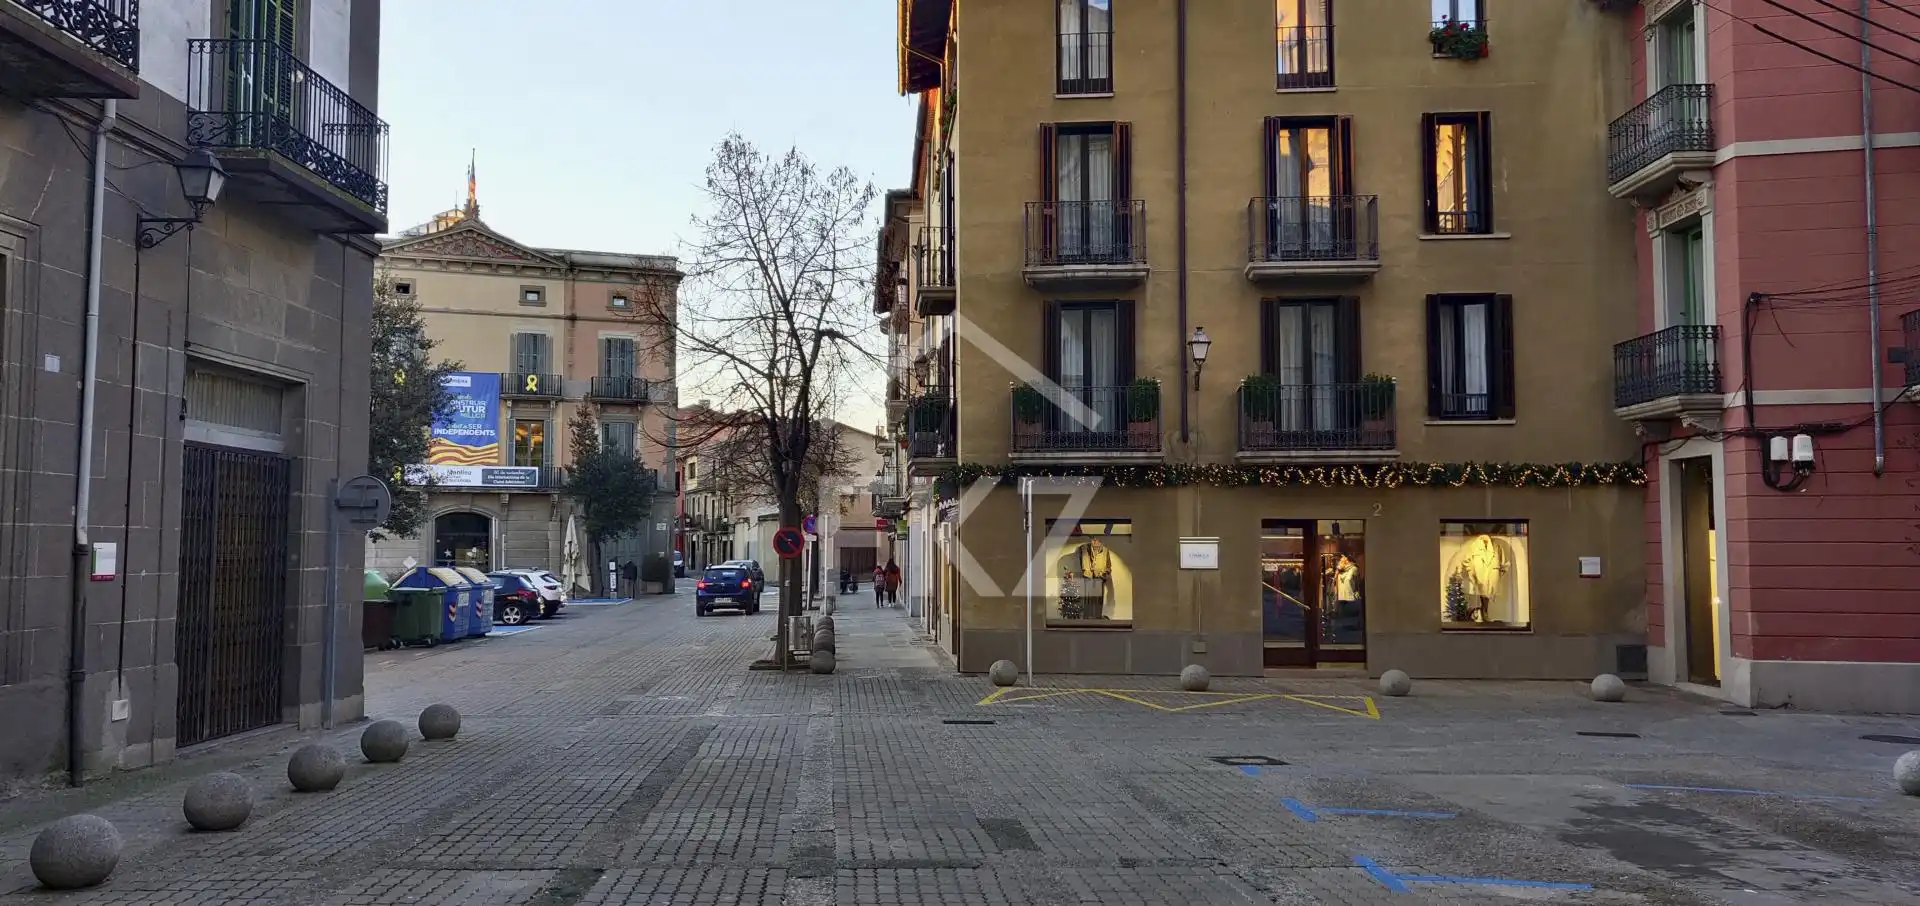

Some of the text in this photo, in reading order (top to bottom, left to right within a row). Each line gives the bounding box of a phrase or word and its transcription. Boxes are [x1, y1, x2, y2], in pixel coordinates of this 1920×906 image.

[448, 399, 487, 407] ONSTRUIR
[456, 405, 486, 414] UTUR
[434, 428, 496, 437] INDEPENDENTS
[1372, 502, 1382, 517] 2
